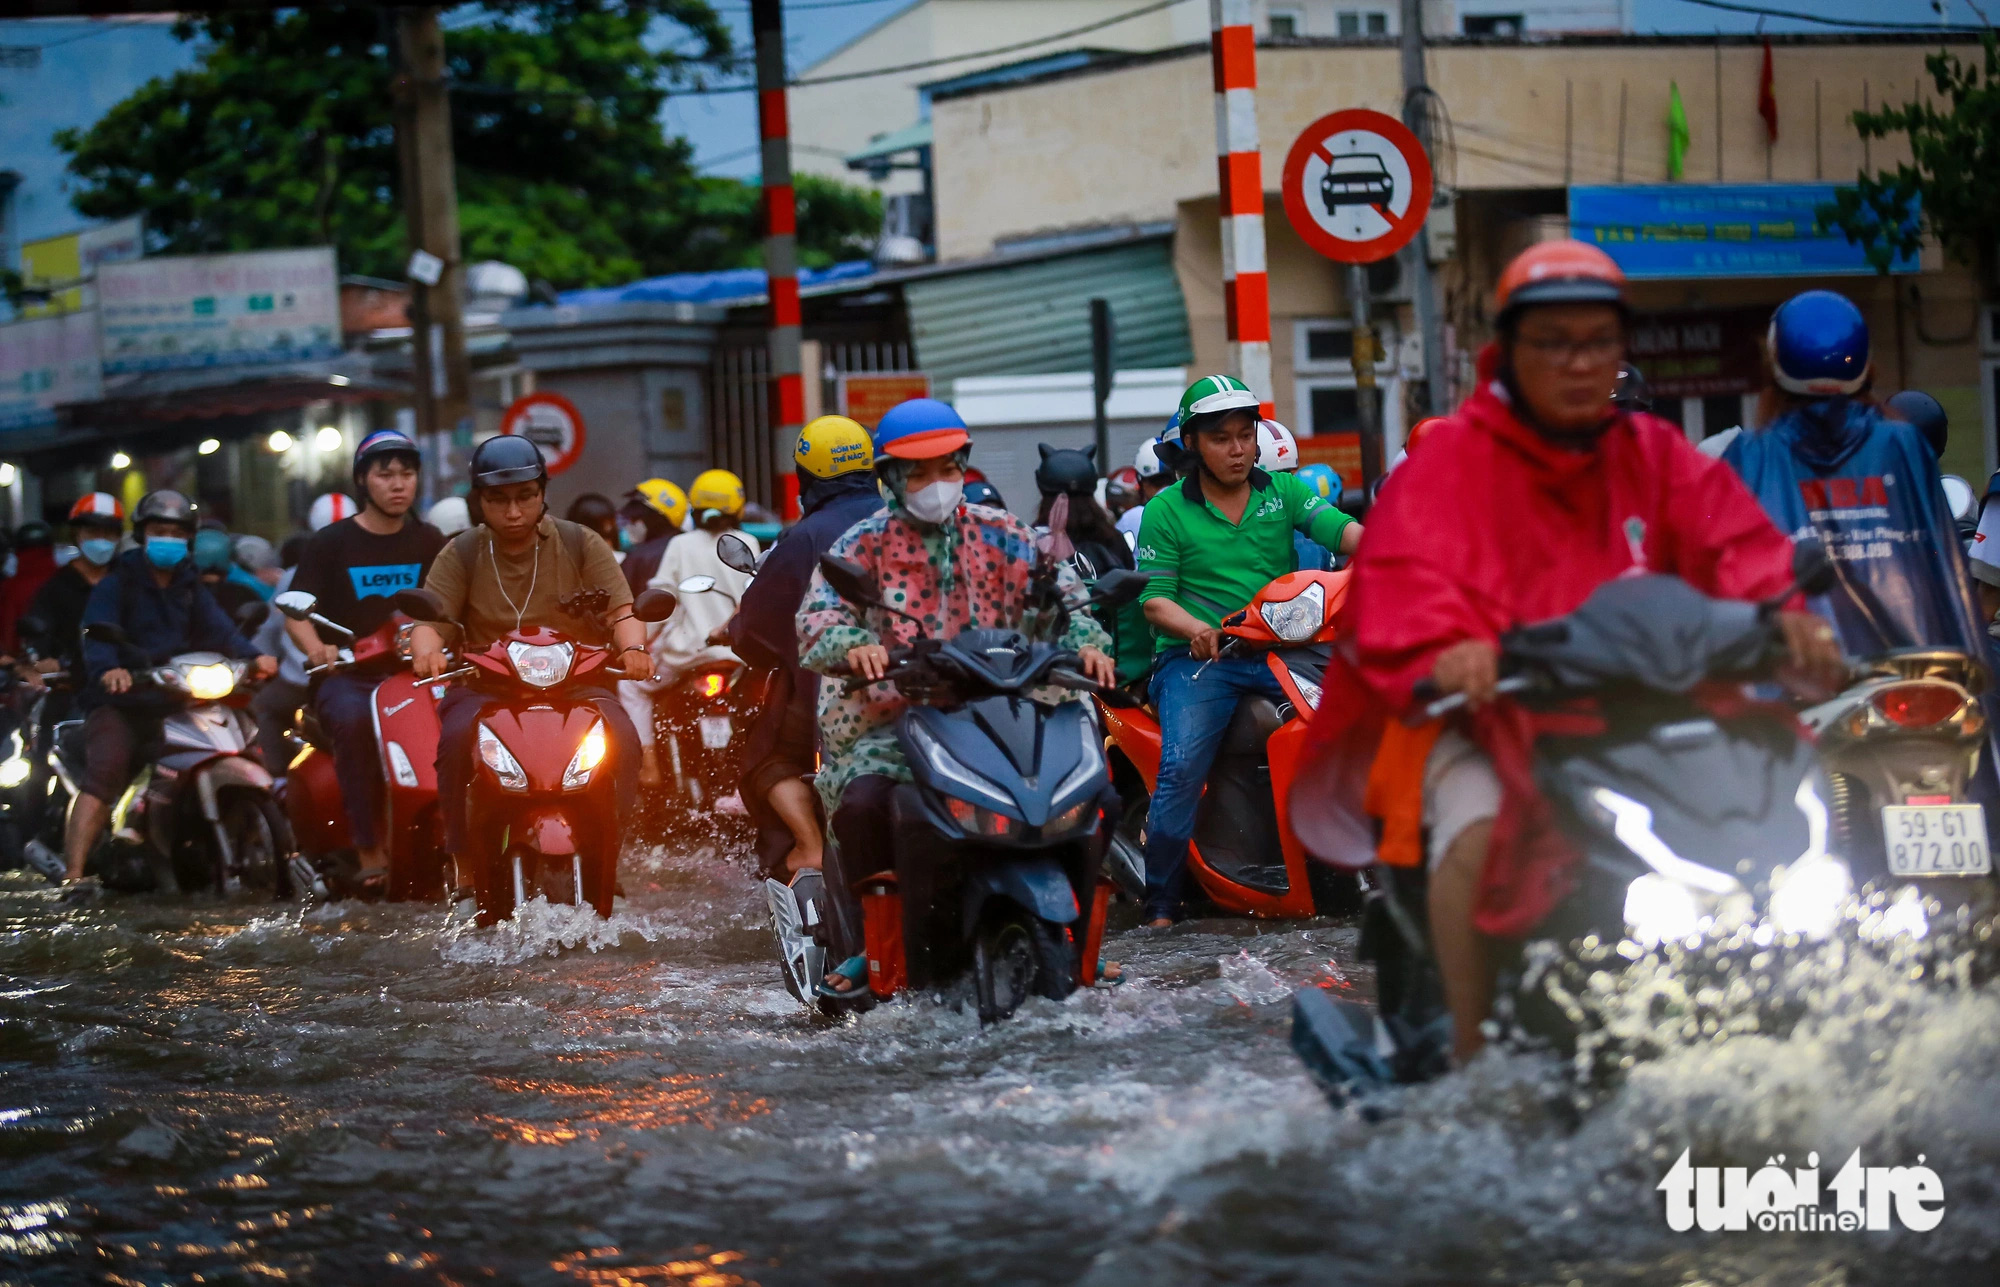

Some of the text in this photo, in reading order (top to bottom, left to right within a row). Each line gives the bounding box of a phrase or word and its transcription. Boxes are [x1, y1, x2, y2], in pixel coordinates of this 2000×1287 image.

[831, 443, 862, 454] HÔM NAY
[833, 454, 847, 463] THẾ
[1256, 496, 1284, 517] Grab
[1899, 811, 1965, 838] 59-G1
